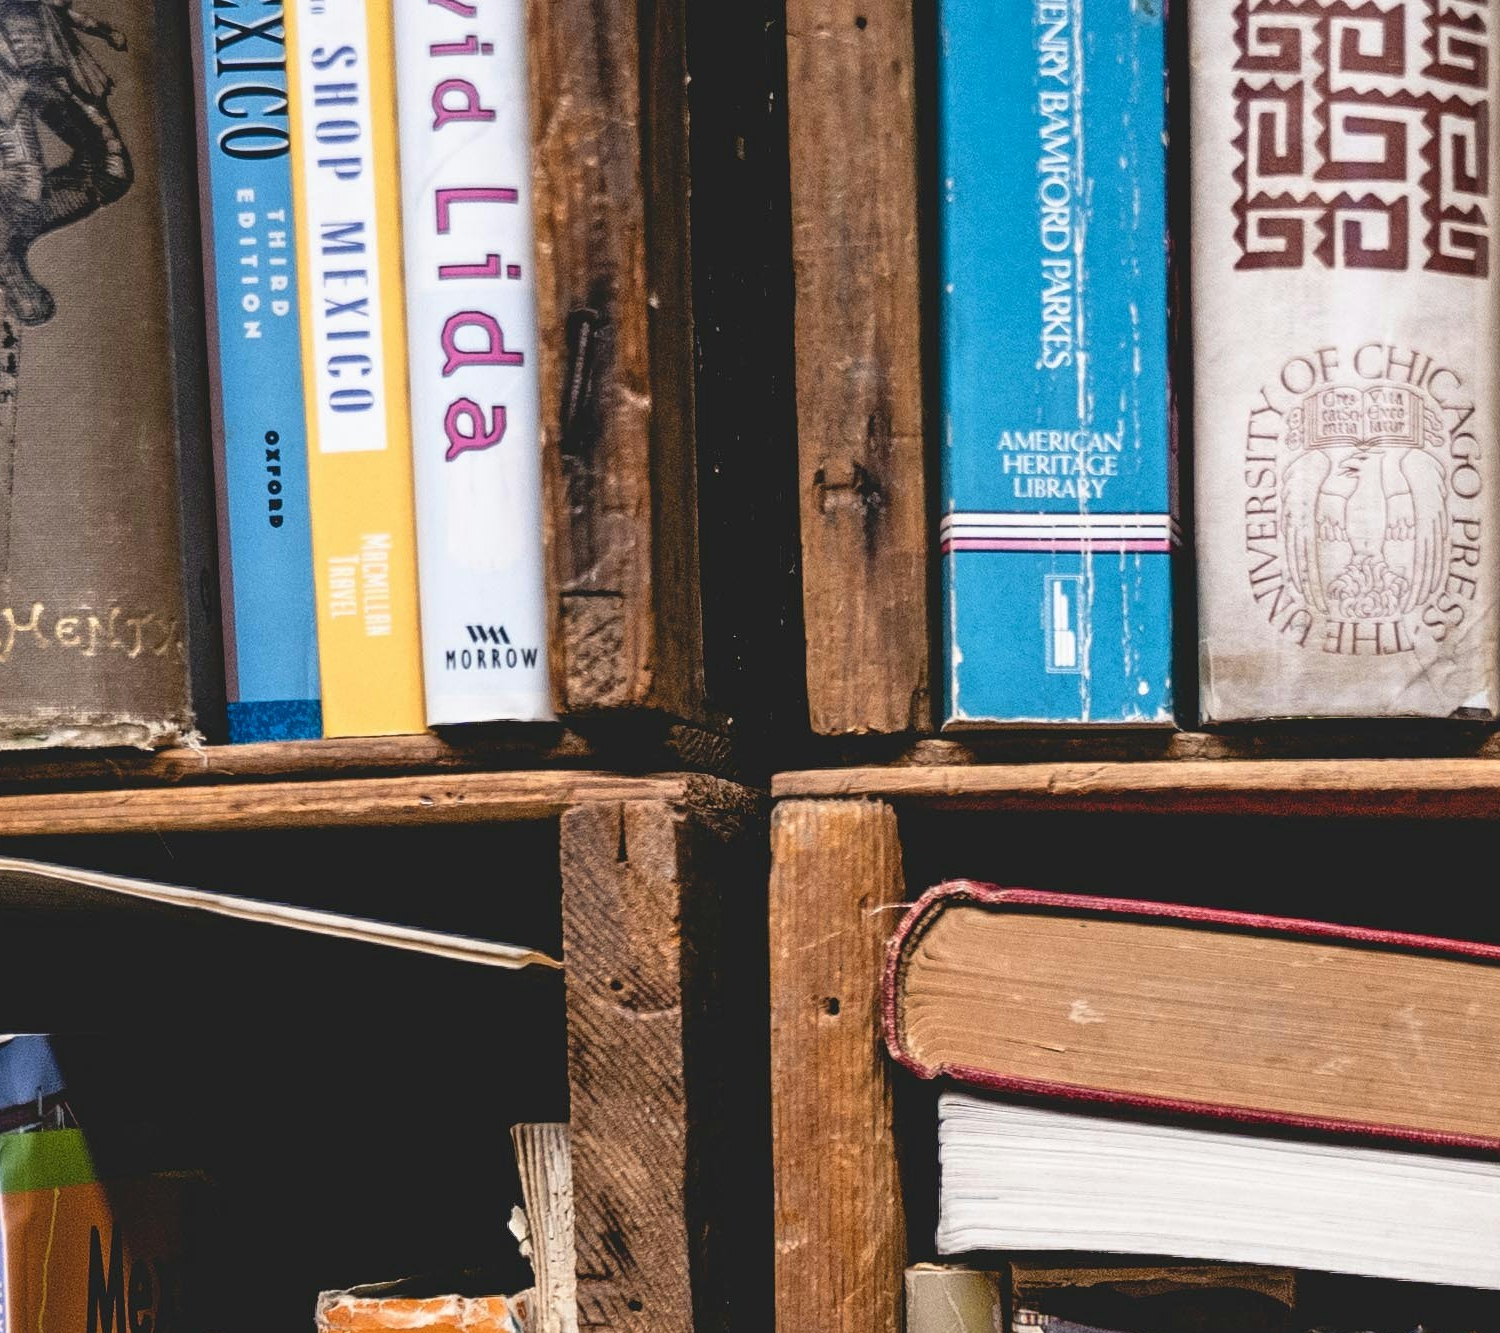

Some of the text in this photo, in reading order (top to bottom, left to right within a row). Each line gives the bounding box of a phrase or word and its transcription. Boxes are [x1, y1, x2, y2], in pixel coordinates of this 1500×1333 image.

[308, 45, 374, 415] SHOP MEXICO
[1033, 83, 1076, 369] BAMFORD PARKES
[998, 431, 1122, 454] AMERICAN
[1002, 455, 1118, 476] HERITAGE
[263, 430, 283, 528] OXFORD
[1013, 479, 1108, 500] LIBRARY
[445, 646, 538, 670] MORROW
